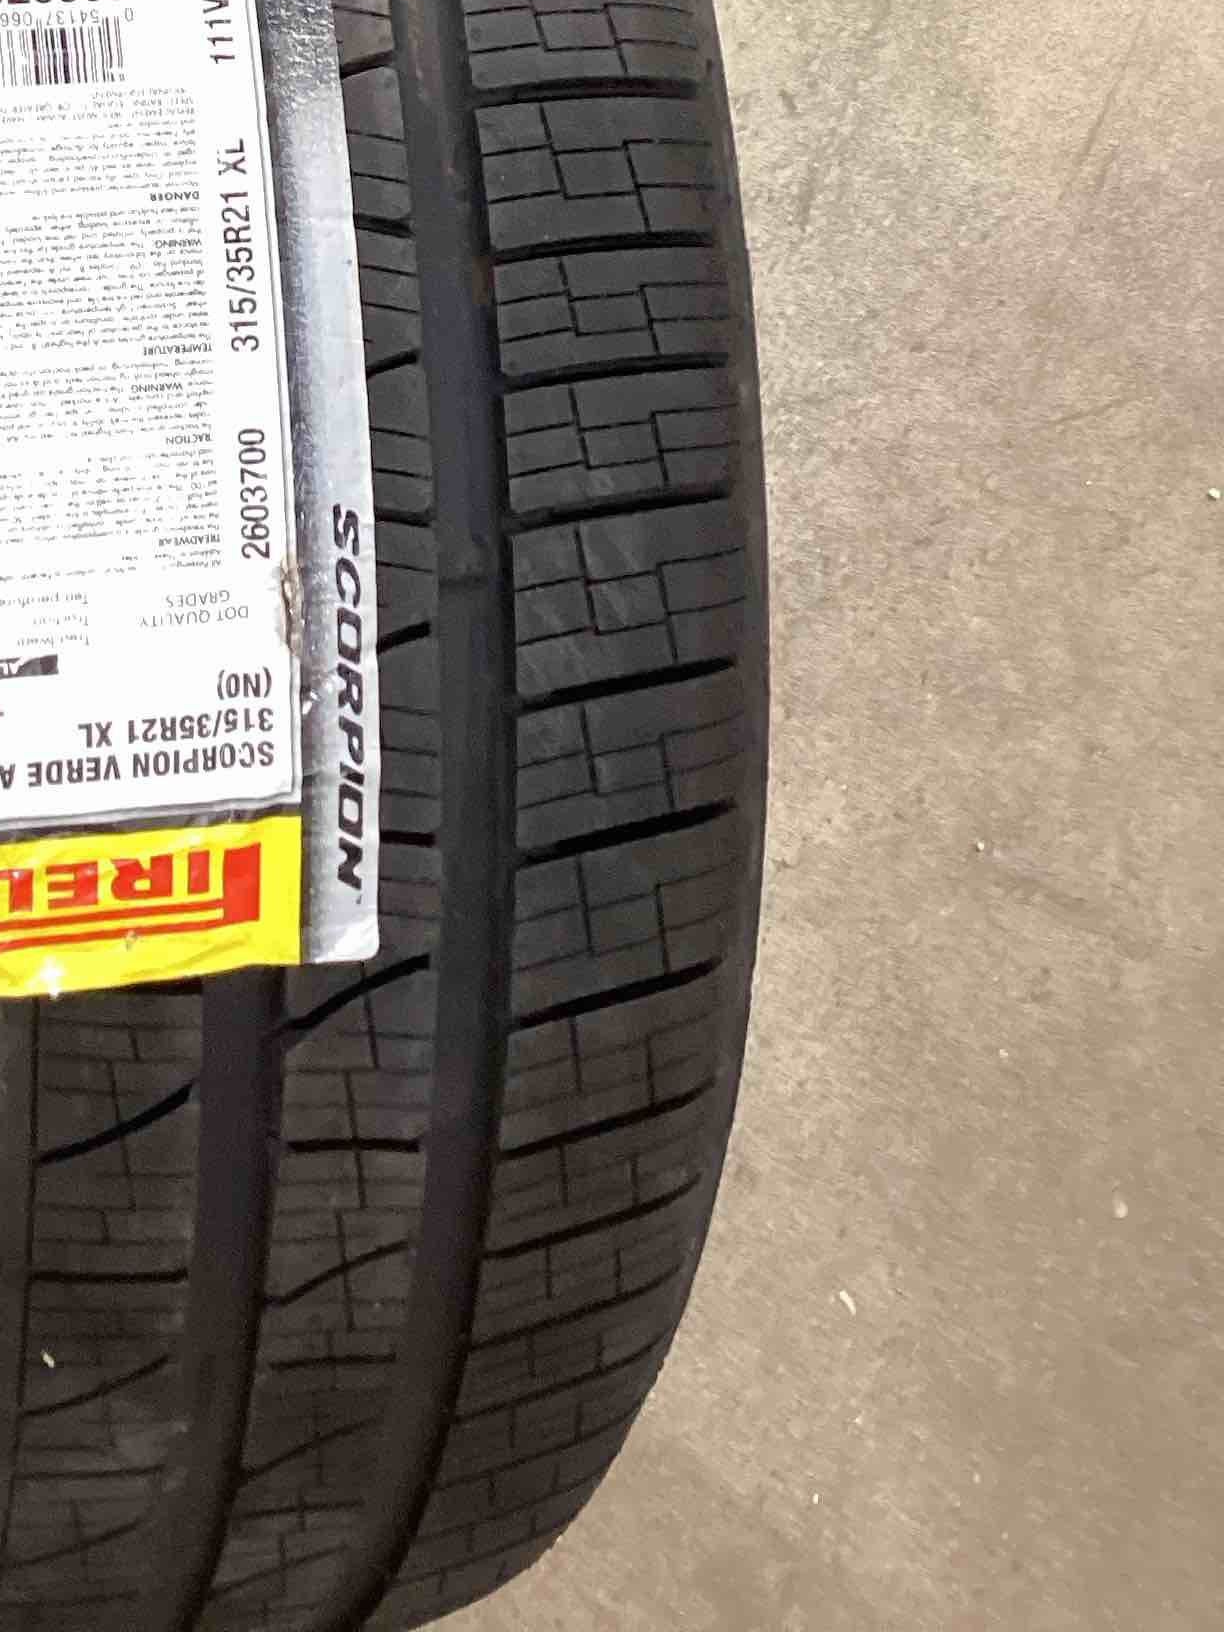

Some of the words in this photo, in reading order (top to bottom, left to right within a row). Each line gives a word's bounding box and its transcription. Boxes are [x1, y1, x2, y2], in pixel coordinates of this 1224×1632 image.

[46, 9, 99, 27] 54137
[124, 7, 134, 21] 0
[217, 138, 247, 175] XL
[149, 190, 199, 202] DANGER
[219, 191, 260, 353] 315/35R21
[236, 427, 271, 560] 2603700
[165, 589, 230, 607] GRADES
[139, 609, 211, 627] QUALITY
[216, 605, 249, 621] DOT
[78, 721, 111, 748] XL
[127, 707, 274, 746] 315/35R21
[27, 755, 120, 788] VERDE
[132, 741, 274, 778] SCORPION
